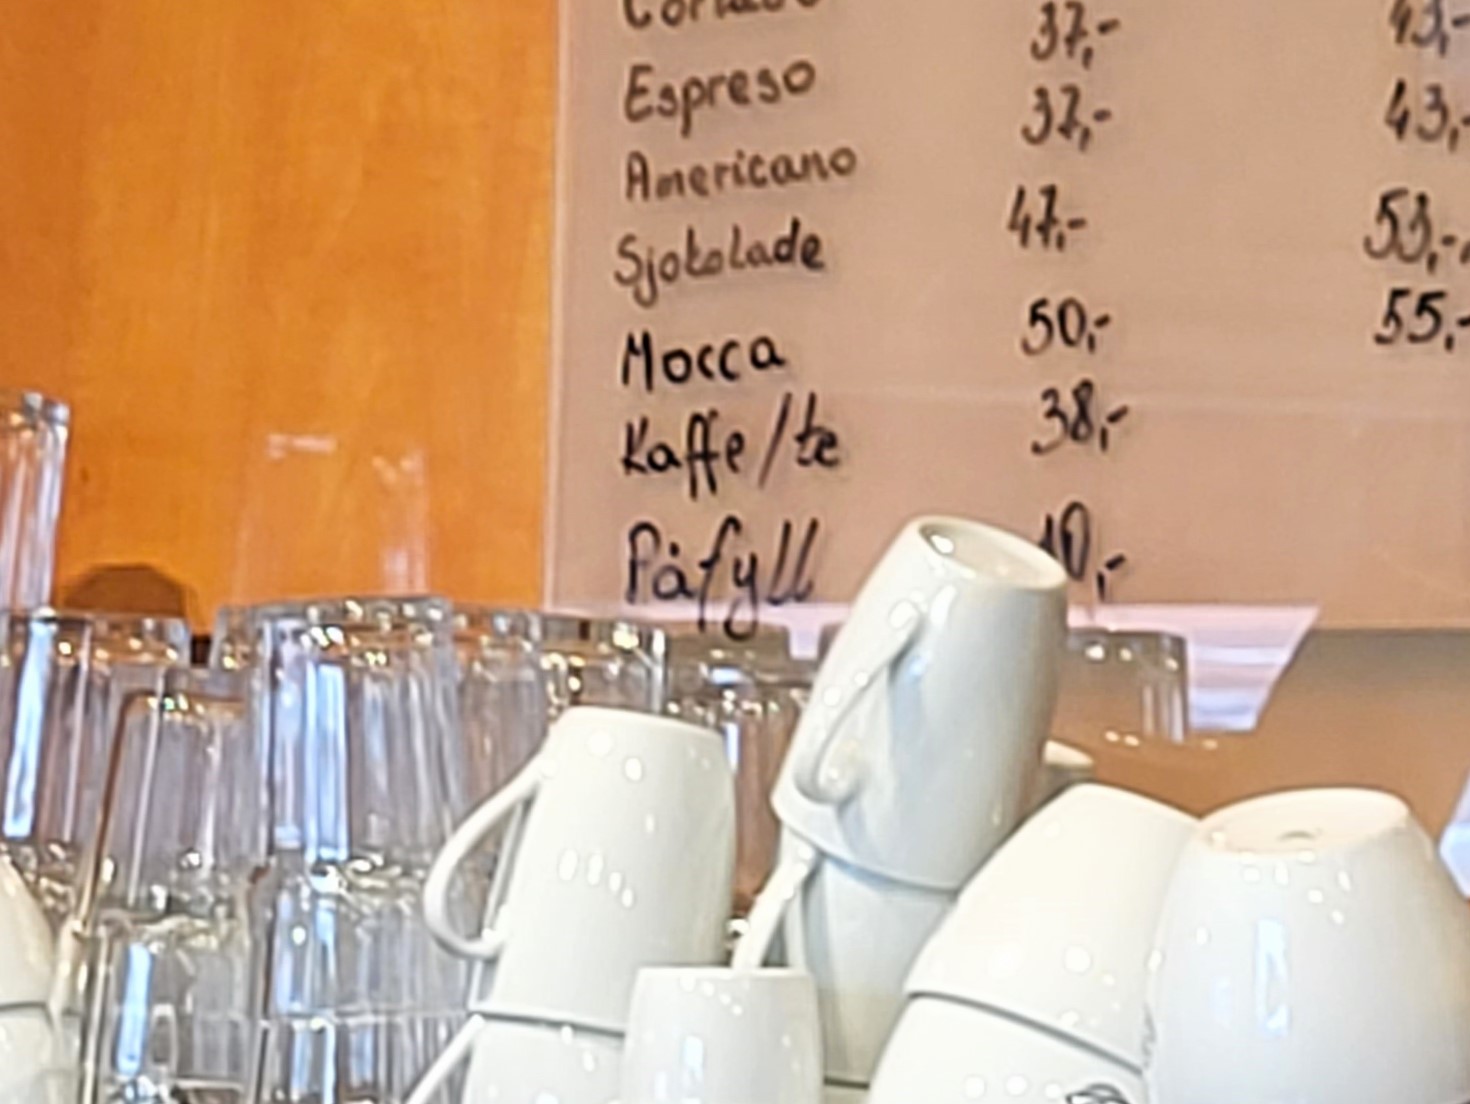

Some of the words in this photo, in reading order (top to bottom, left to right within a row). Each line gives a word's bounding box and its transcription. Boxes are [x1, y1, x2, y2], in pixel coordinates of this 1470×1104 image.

[623, 59, 817, 137] Espreso
[1030, 0, 1121, 69] 37,-
[625, 145, 858, 203] Americano
[612, 217, 827, 308] Sjokolade
[621, 330, 788, 392] Mocca
[1020, 296, 1113, 355] 50,-
[1031, 379, 1130, 456] 38,-
[623, 514, 821, 639] Påfyll
